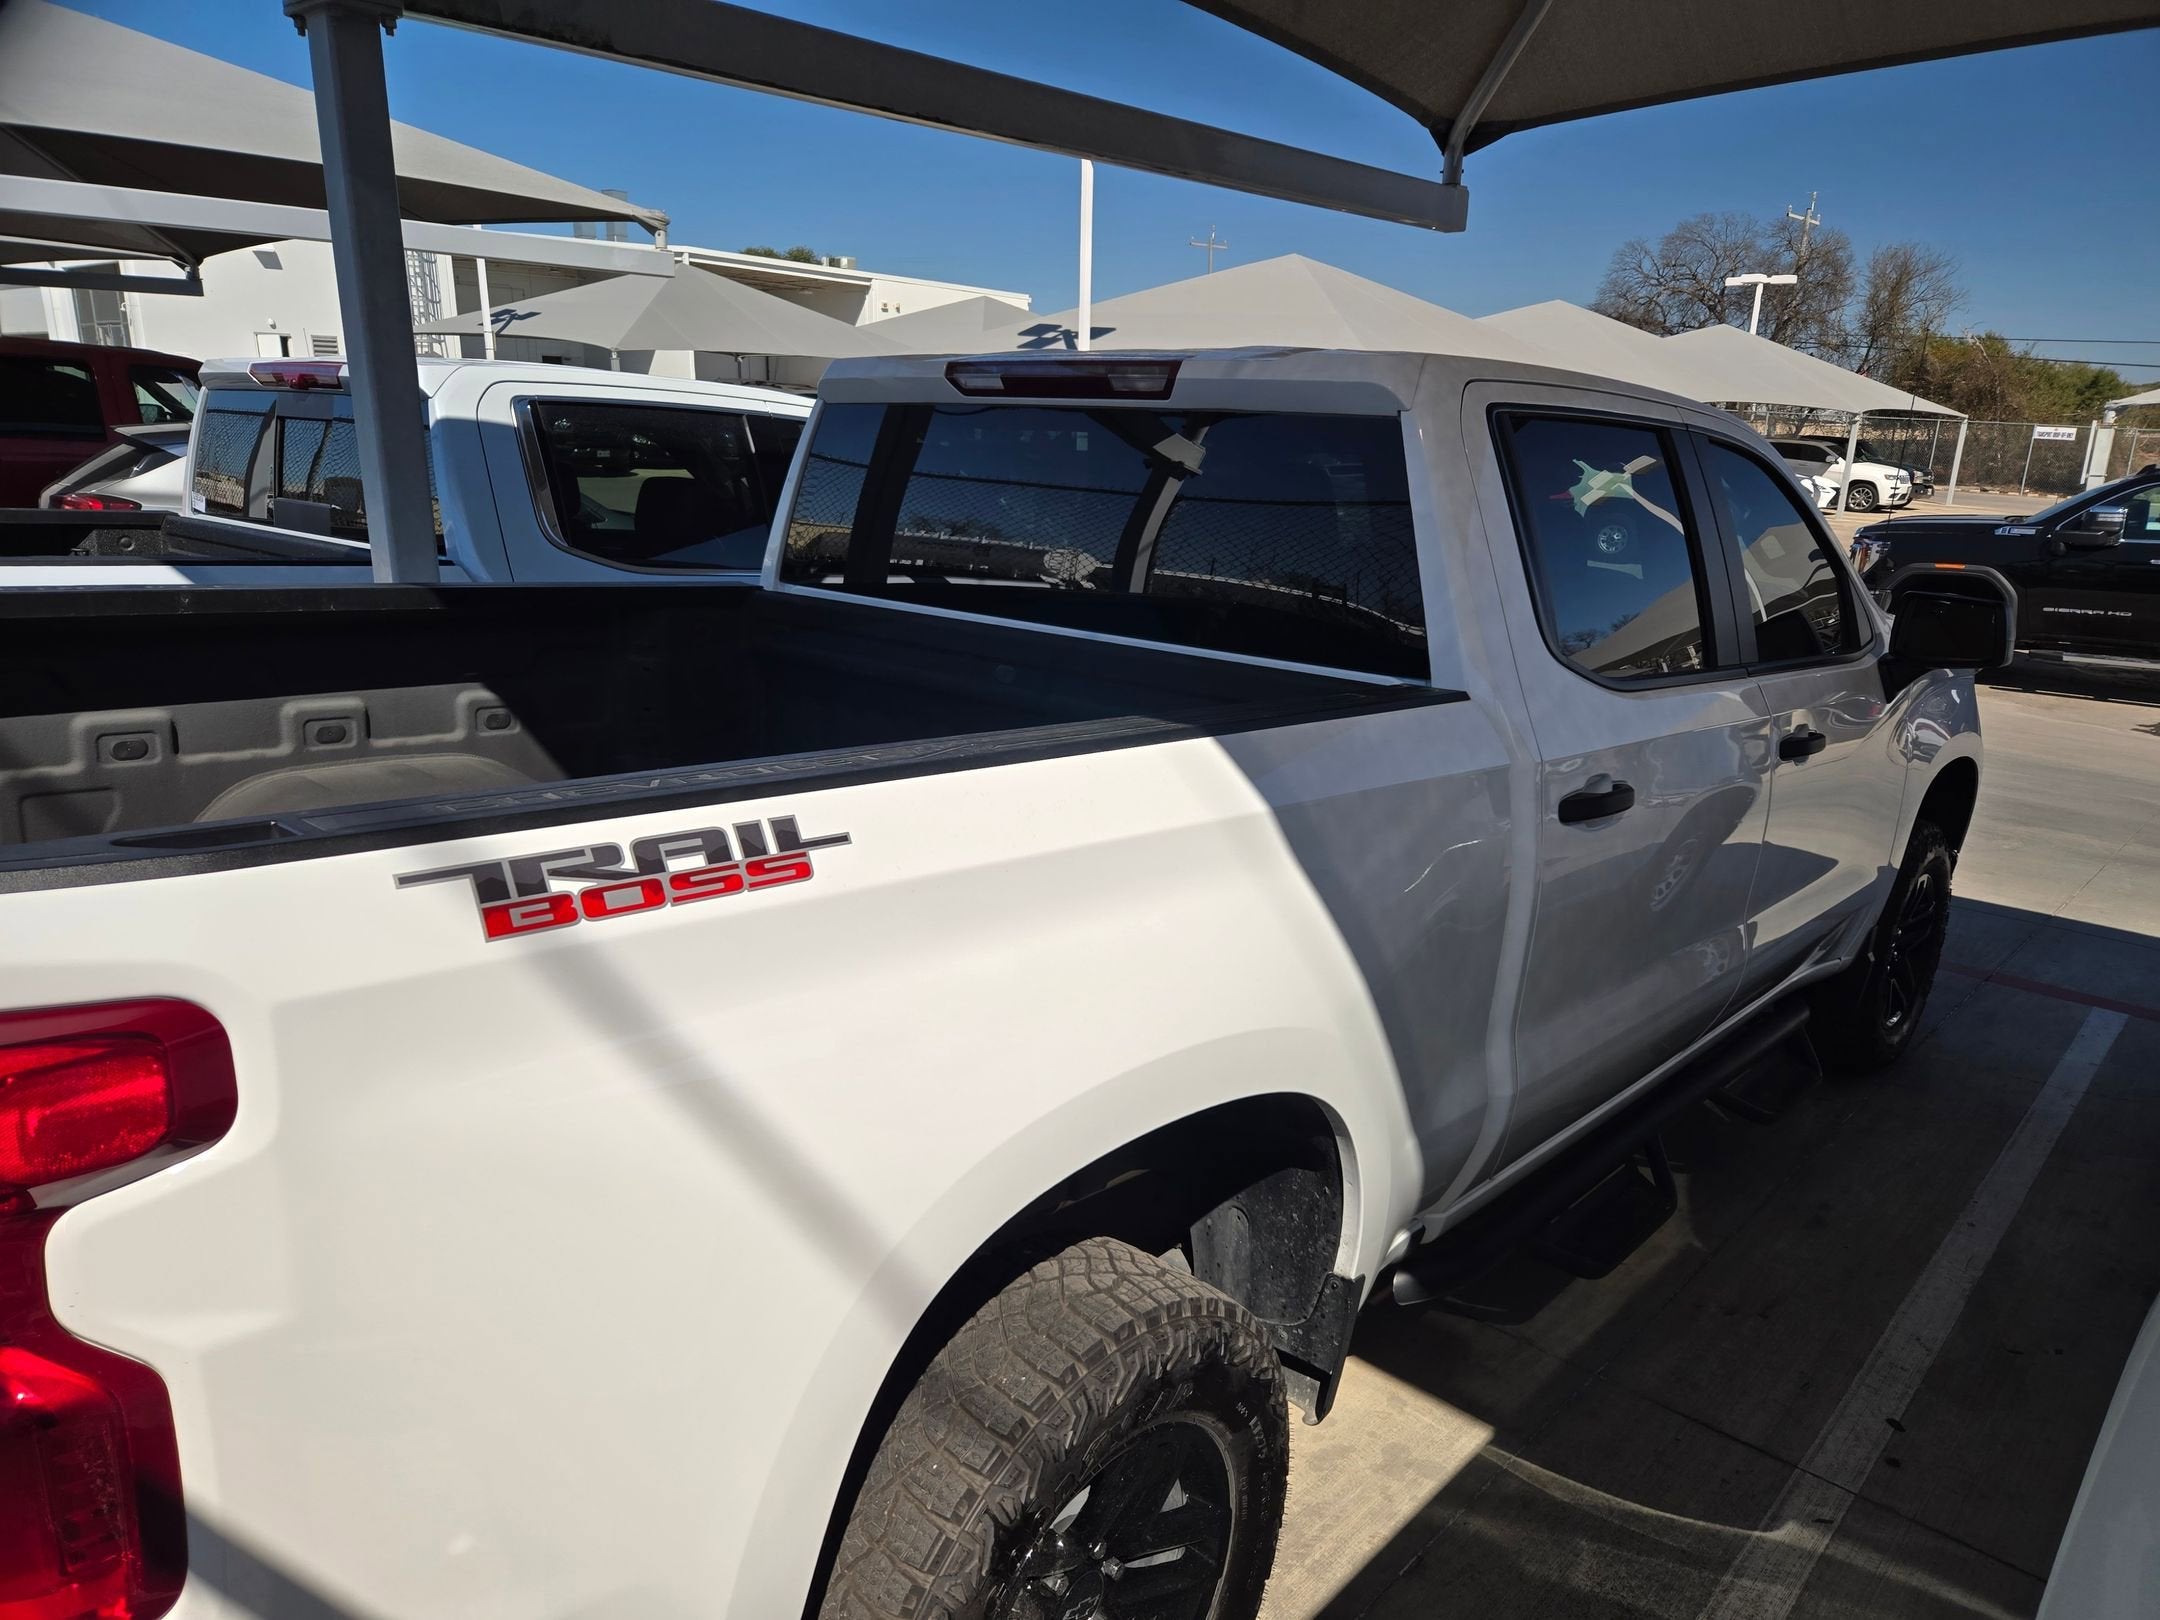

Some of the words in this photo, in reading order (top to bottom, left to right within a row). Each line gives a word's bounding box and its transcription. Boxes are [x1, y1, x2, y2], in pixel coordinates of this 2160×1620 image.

[2043, 607, 2104, 615] SIERRA
[436, 752, 881, 811] CHEVROLET
[393, 815, 852, 904] TRAIL
[481, 850, 815, 942] BOSS
